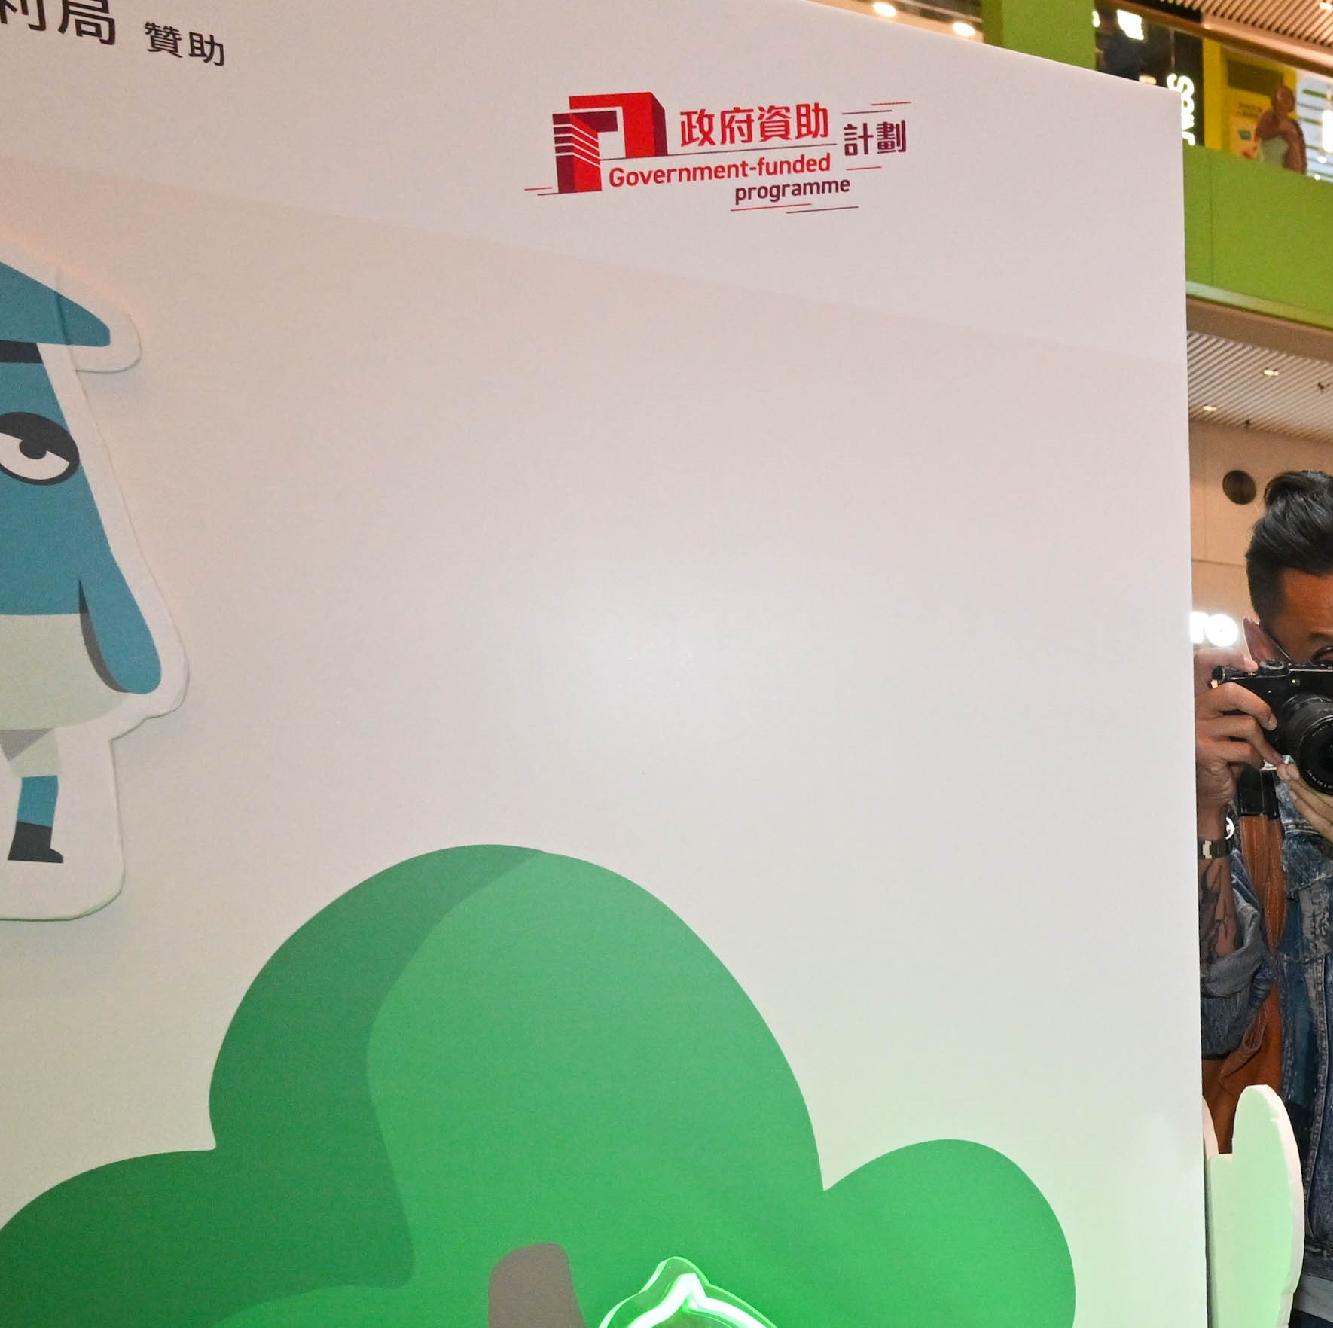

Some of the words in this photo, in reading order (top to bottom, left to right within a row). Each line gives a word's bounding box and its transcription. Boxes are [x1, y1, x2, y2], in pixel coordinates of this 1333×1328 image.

[145, 22, 225, 66] 贊助
[680, 102, 829, 147] 政府資助
[844, 120, 907, 156] 計劃
[609, 153, 832, 187] Government-funded
[735, 178, 852, 205] programme
